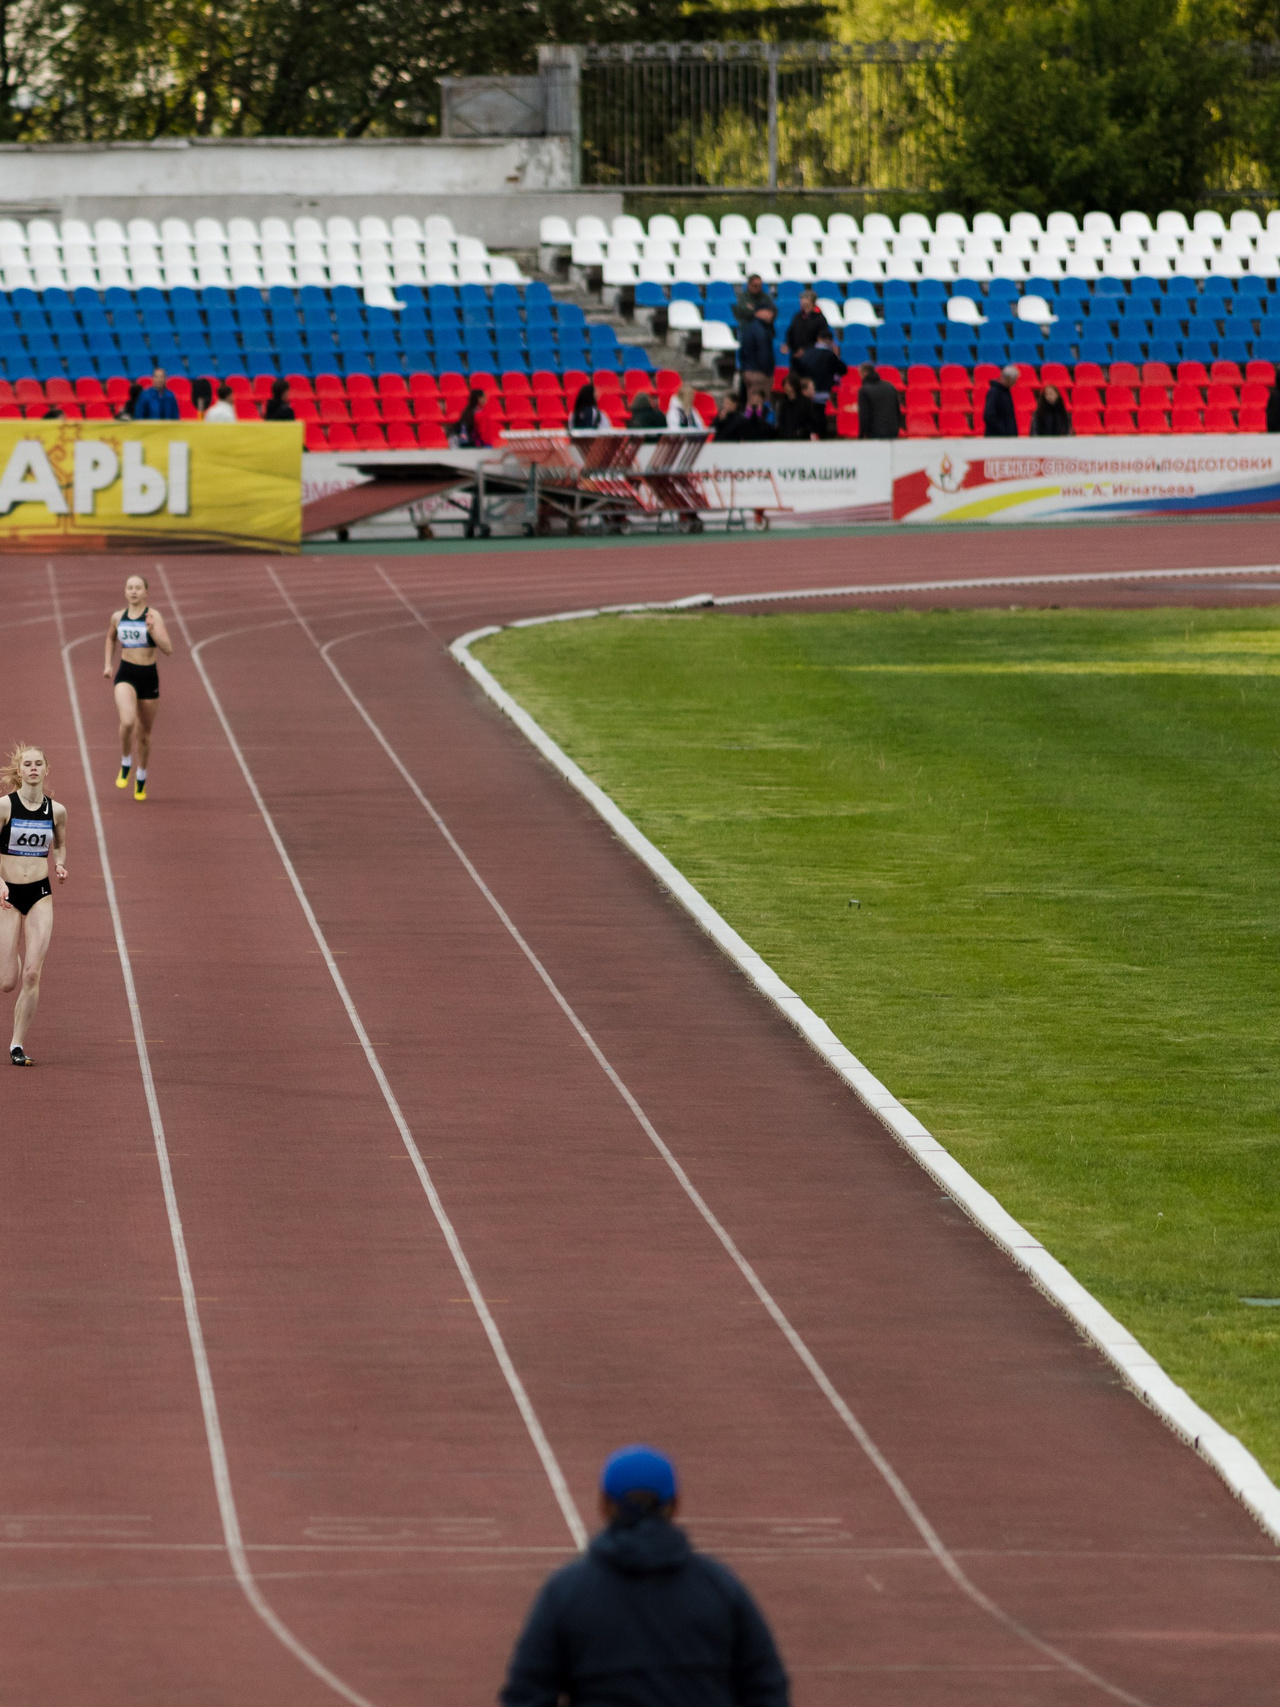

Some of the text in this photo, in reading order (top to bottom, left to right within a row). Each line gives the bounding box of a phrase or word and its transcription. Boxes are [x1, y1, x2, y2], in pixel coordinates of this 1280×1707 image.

[778, 466, 856, 481] ЧУВАШИИ
[984, 455, 1272, 480] ЦЕНТР СПОРТИВНОЙ ПОДГОТОВКИ
[122, 629, 140, 640] 319
[16, 833, 47, 847] 601
